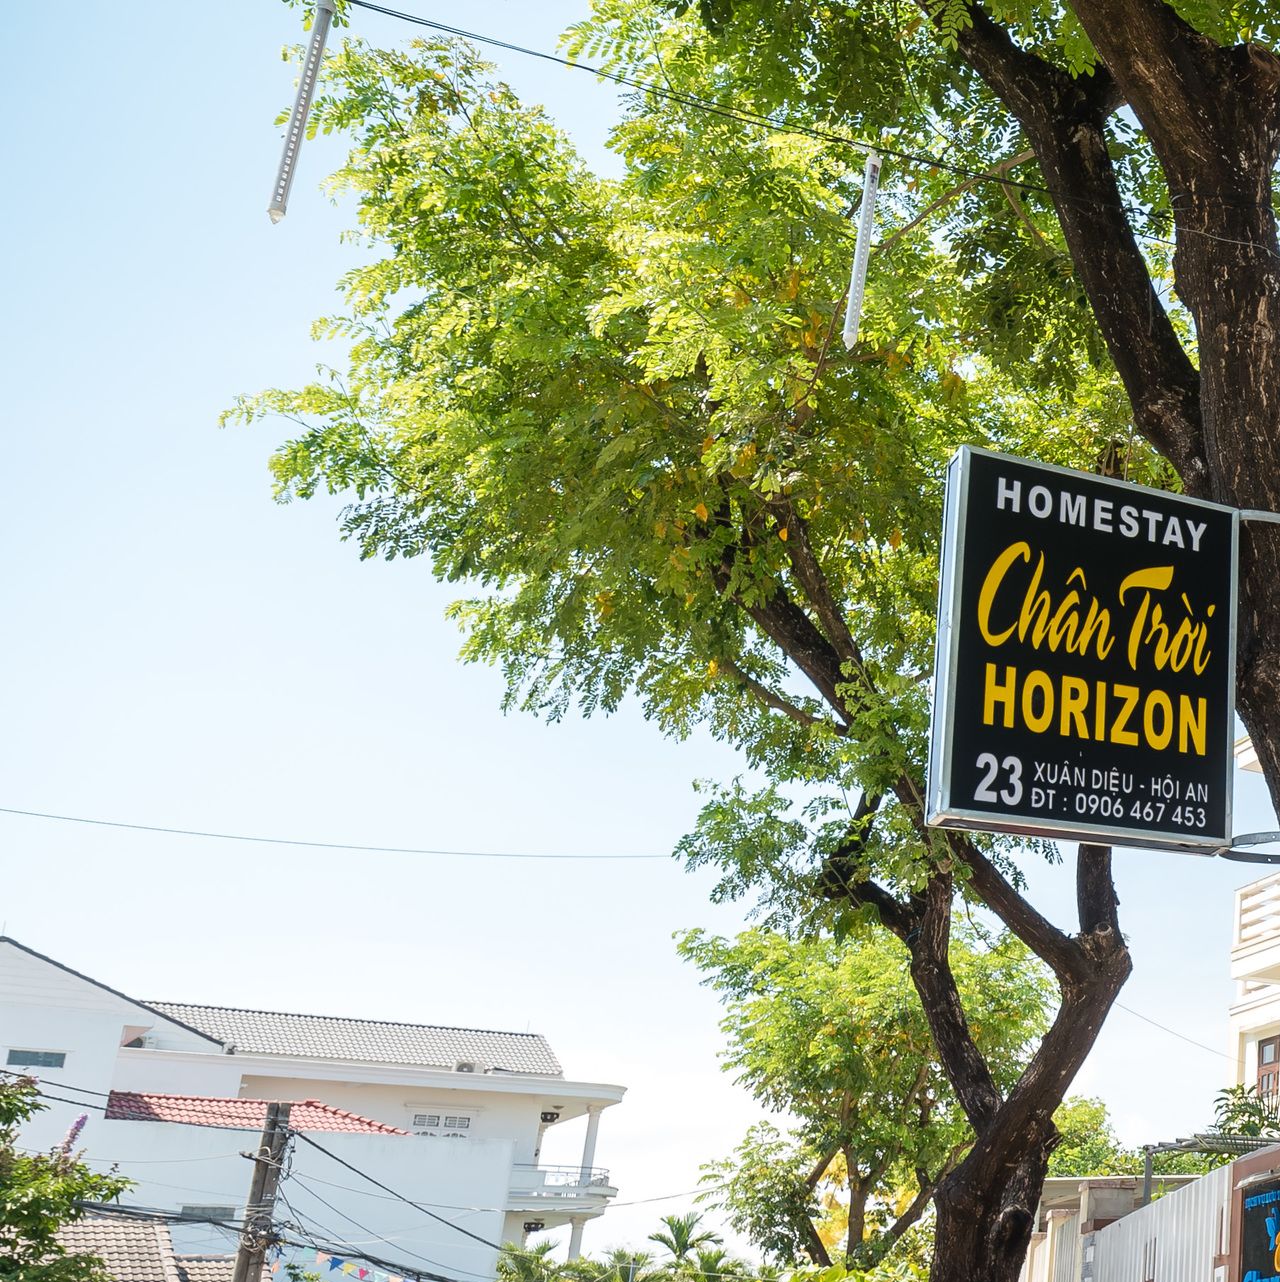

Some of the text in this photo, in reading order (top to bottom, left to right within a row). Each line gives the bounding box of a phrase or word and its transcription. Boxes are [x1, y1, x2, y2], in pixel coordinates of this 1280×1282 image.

[996, 476, 1208, 552] HOMESTAY
[977, 541, 1216, 675] Chân Trời
[982, 662, 1207, 756] HORIZON
[973, 752, 1023, 806] 23
[1030, 786, 1057, 810] ĐT
[1075, 792, 1124, 819] 0906
[1129, 799, 1167, 823] 467
[1171, 805, 1207, 828] 453
[1033, 761, 1086, 788] XUÂN
[1091, 766, 1133, 794] DIỆU
[1151, 776, 1183, 802] HỘI
[1185, 780, 1208, 803] AN
